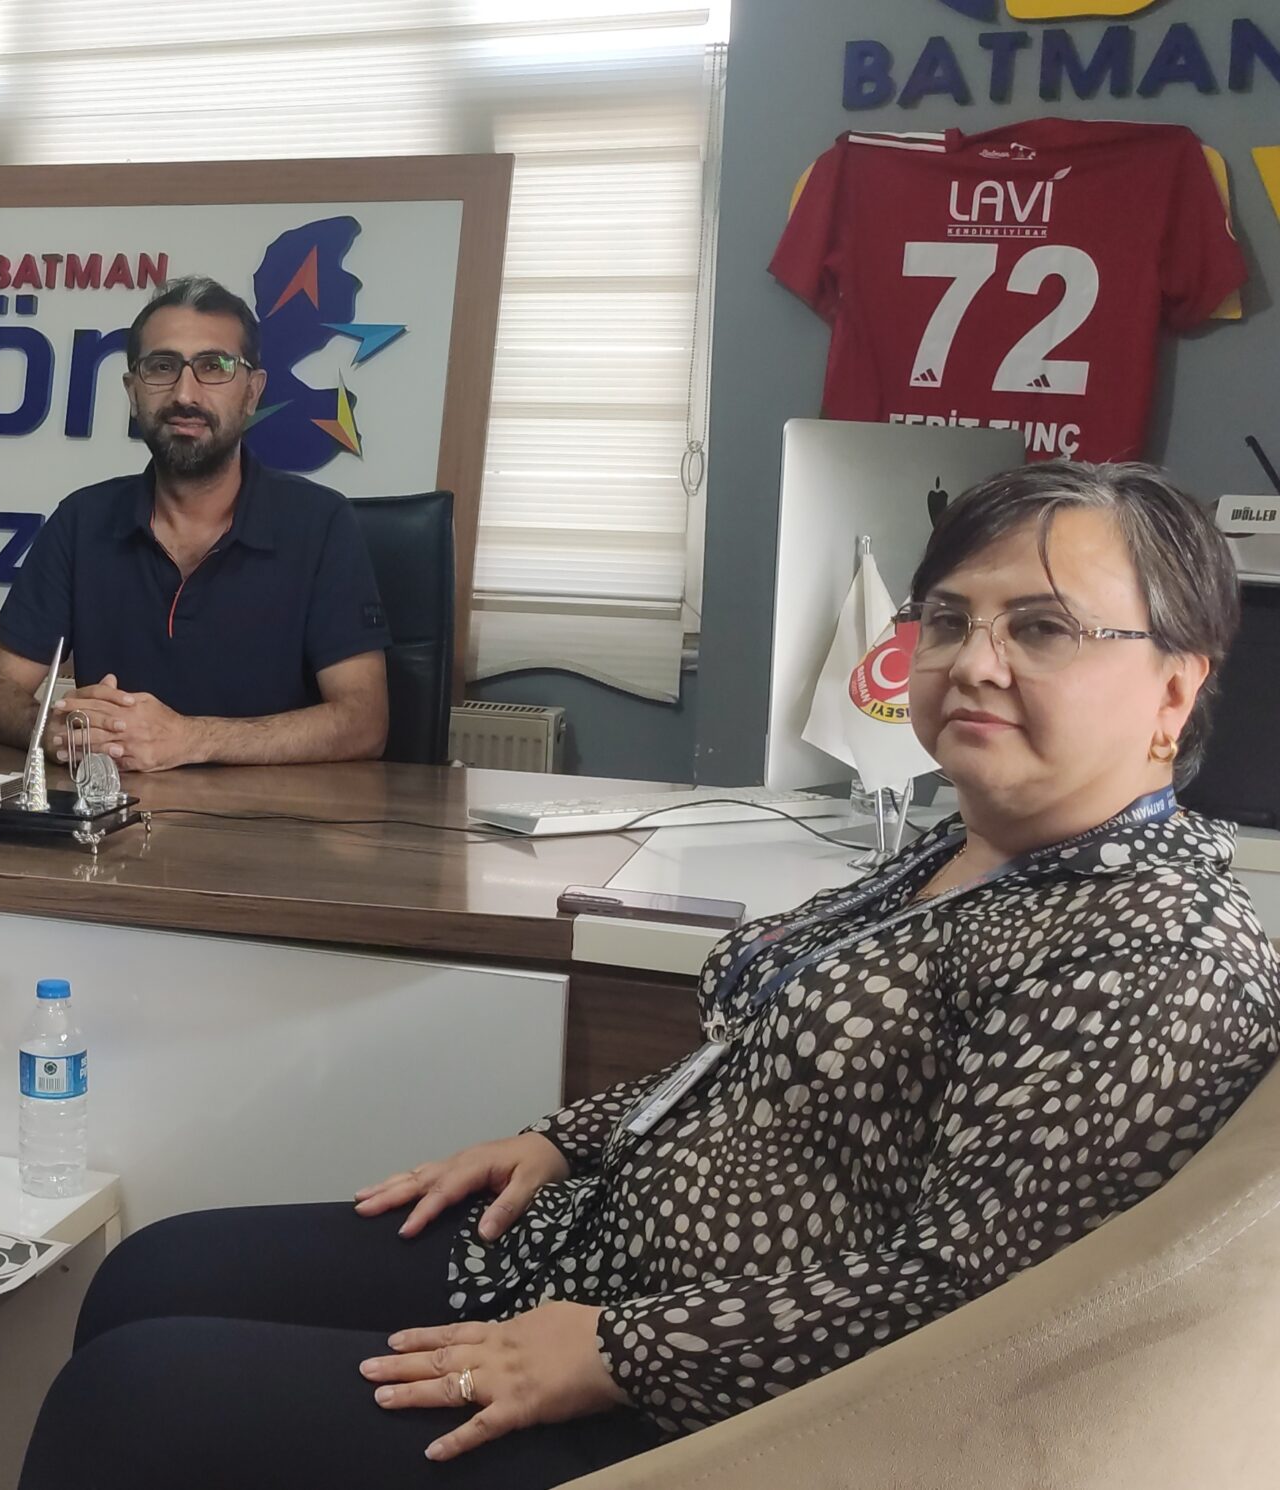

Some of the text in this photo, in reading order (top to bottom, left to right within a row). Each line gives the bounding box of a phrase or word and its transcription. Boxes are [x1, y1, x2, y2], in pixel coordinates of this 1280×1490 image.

[841, 18, 1280, 110] BATMAN
[902, 241, 1101, 396] 72
[1130, 798, 1164, 821] BATMAN
